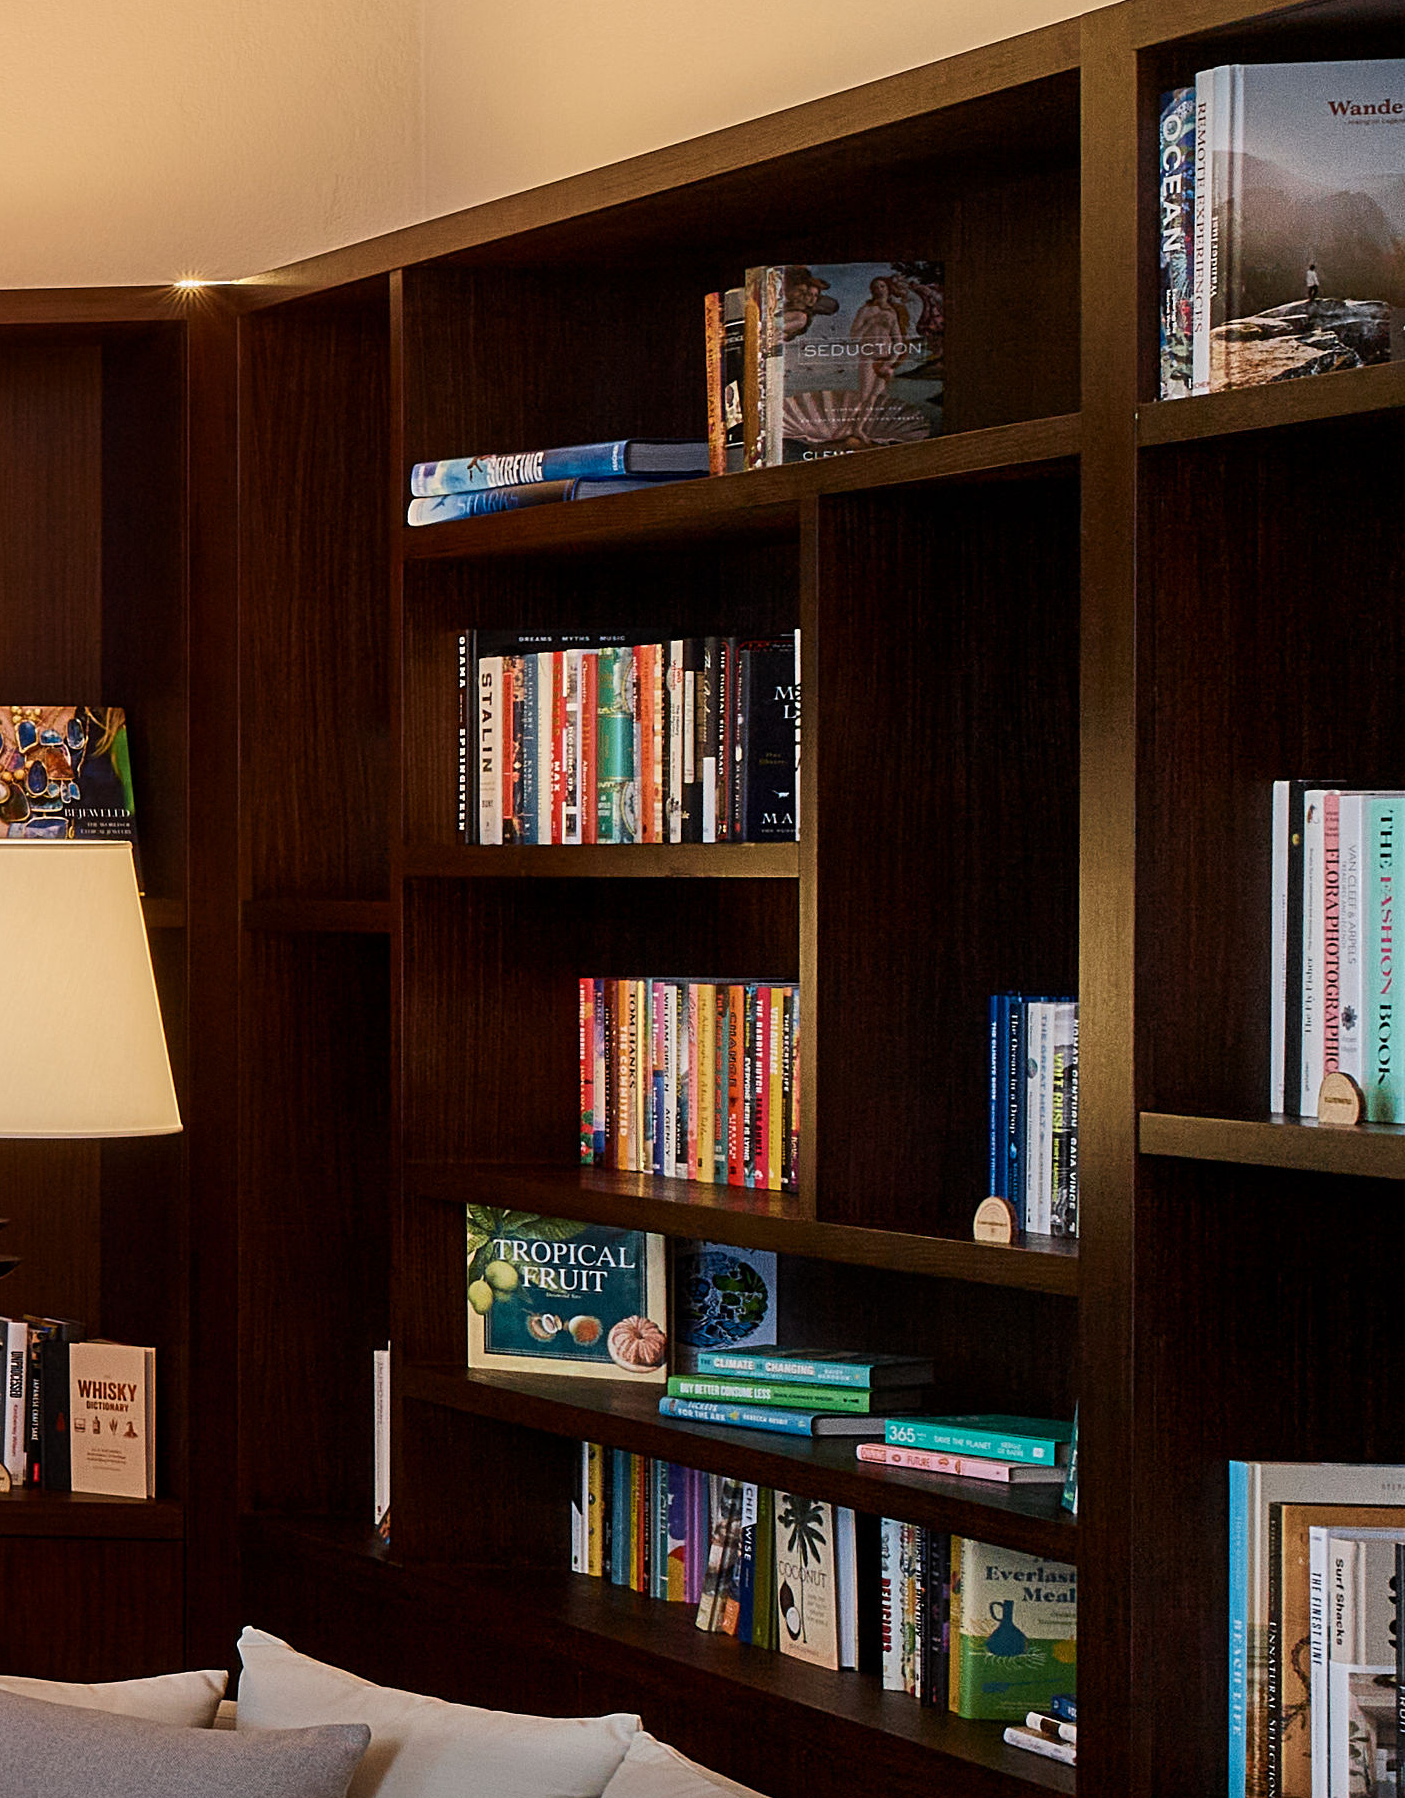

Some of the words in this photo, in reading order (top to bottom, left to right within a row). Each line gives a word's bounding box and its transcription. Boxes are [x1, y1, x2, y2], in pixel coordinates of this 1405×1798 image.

[1162, 115, 1183, 253] OCEAN
[804, 342, 922, 357] SEDUCTION
[487, 452, 544, 486] SURFING
[481, 673, 493, 773] STALIN
[1380, 809, 1393, 869] THE
[1325, 848, 1339, 913] FLORA
[1380, 877, 1393, 995] FASHION
[1325, 916, 1339, 1073] PHOTOGRAPHIC
[1378, 1005, 1392, 1085] BOOK
[1053, 1053, 1064, 1088] VOLT
[1053, 1091, 1064, 1133] RUSH
[493, 1239, 636, 1269] TROPICAL
[522, 1266, 608, 1292] FRUIT
[10, 1351, 23, 1398] UNPROCESSED
[714, 1358, 755, 1371] CLIMATE
[765, 1361, 815, 1376] CHANGING
[78, 1379, 137, 1402] WHISKY
[86, 1401, 129, 1413] DICTIONARY
[890, 1425, 916, 1443] 365
[745, 1487, 754, 1522] CHEF
[744, 1526, 753, 1561] WISE
[778, 1560, 827, 1588] COCONUT
[1312, 1573, 1321, 1591] THE
[1336, 1558, 1344, 1590] Surf
[1311, 1597, 1321, 1635] FINEST
[1336, 1593, 1344, 1646] Shacks
[1268, 1622, 1277, 1709] UNNATURAL
[1312, 1641, 1322, 1666] LINE
[1268, 1719, 1276, 1798] SELECTION
